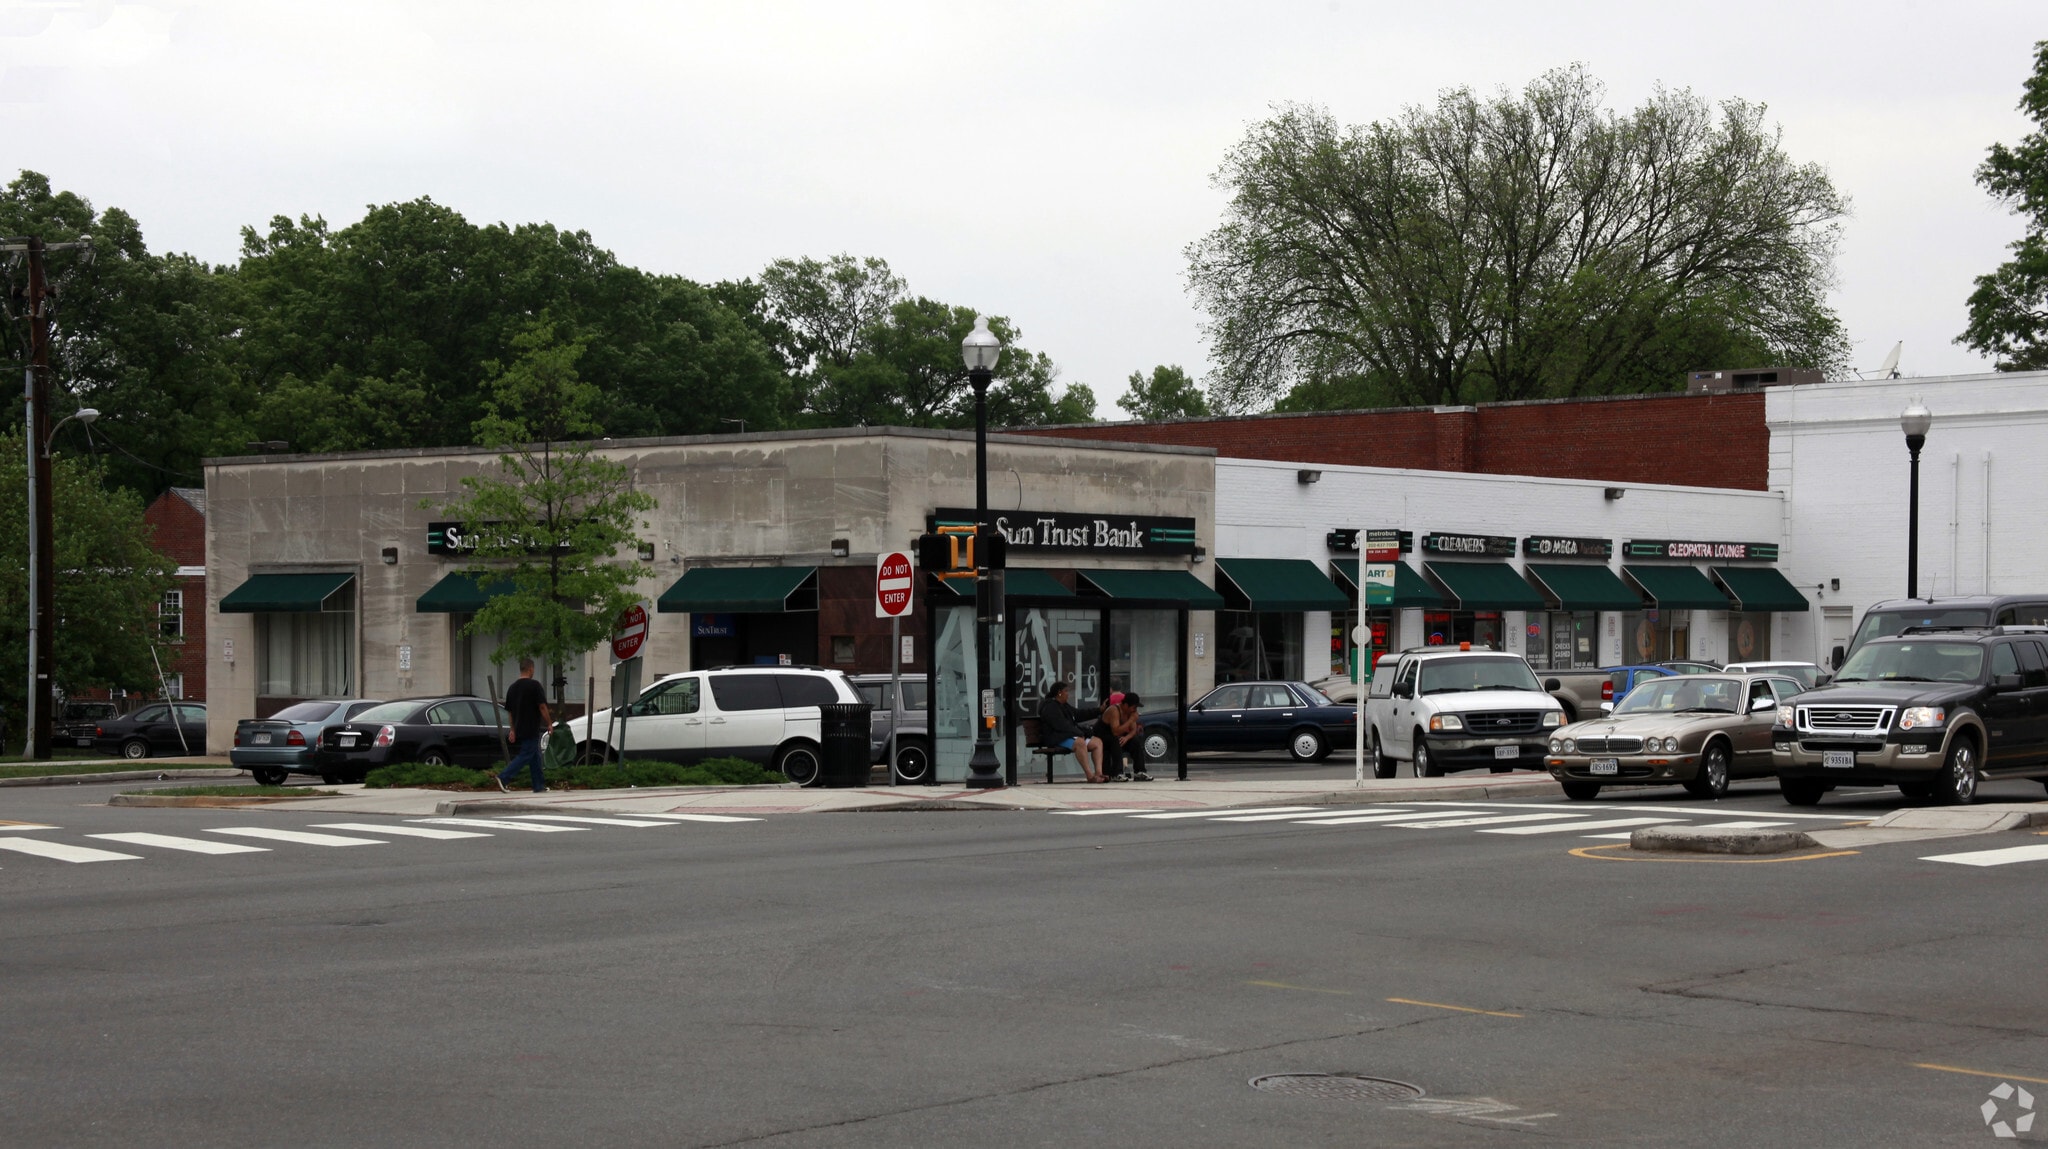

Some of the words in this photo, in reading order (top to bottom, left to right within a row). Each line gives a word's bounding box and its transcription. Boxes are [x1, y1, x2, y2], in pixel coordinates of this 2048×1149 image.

[446, 527, 479, 549] Sun
[996, 517, 1034, 545] Sun
[1037, 518, 1089, 546] Trust
[1094, 520, 1143, 548] Bank
[1438, 536, 1486, 553] CLEANERS
[1540, 539, 1552, 553] CD
[1553, 540, 1578, 554] MEGA
[1668, 543, 1712, 556] CLEOPATRA
[1714, 544, 1746, 558] LOUNGE
[882, 566, 891, 576] DO
[895, 564, 908, 575] NOT
[1367, 569, 1386, 578] ART
[884, 592, 905, 604] ENTER
[629, 612, 643, 623] NOT
[618, 637, 639, 651] ENTER
